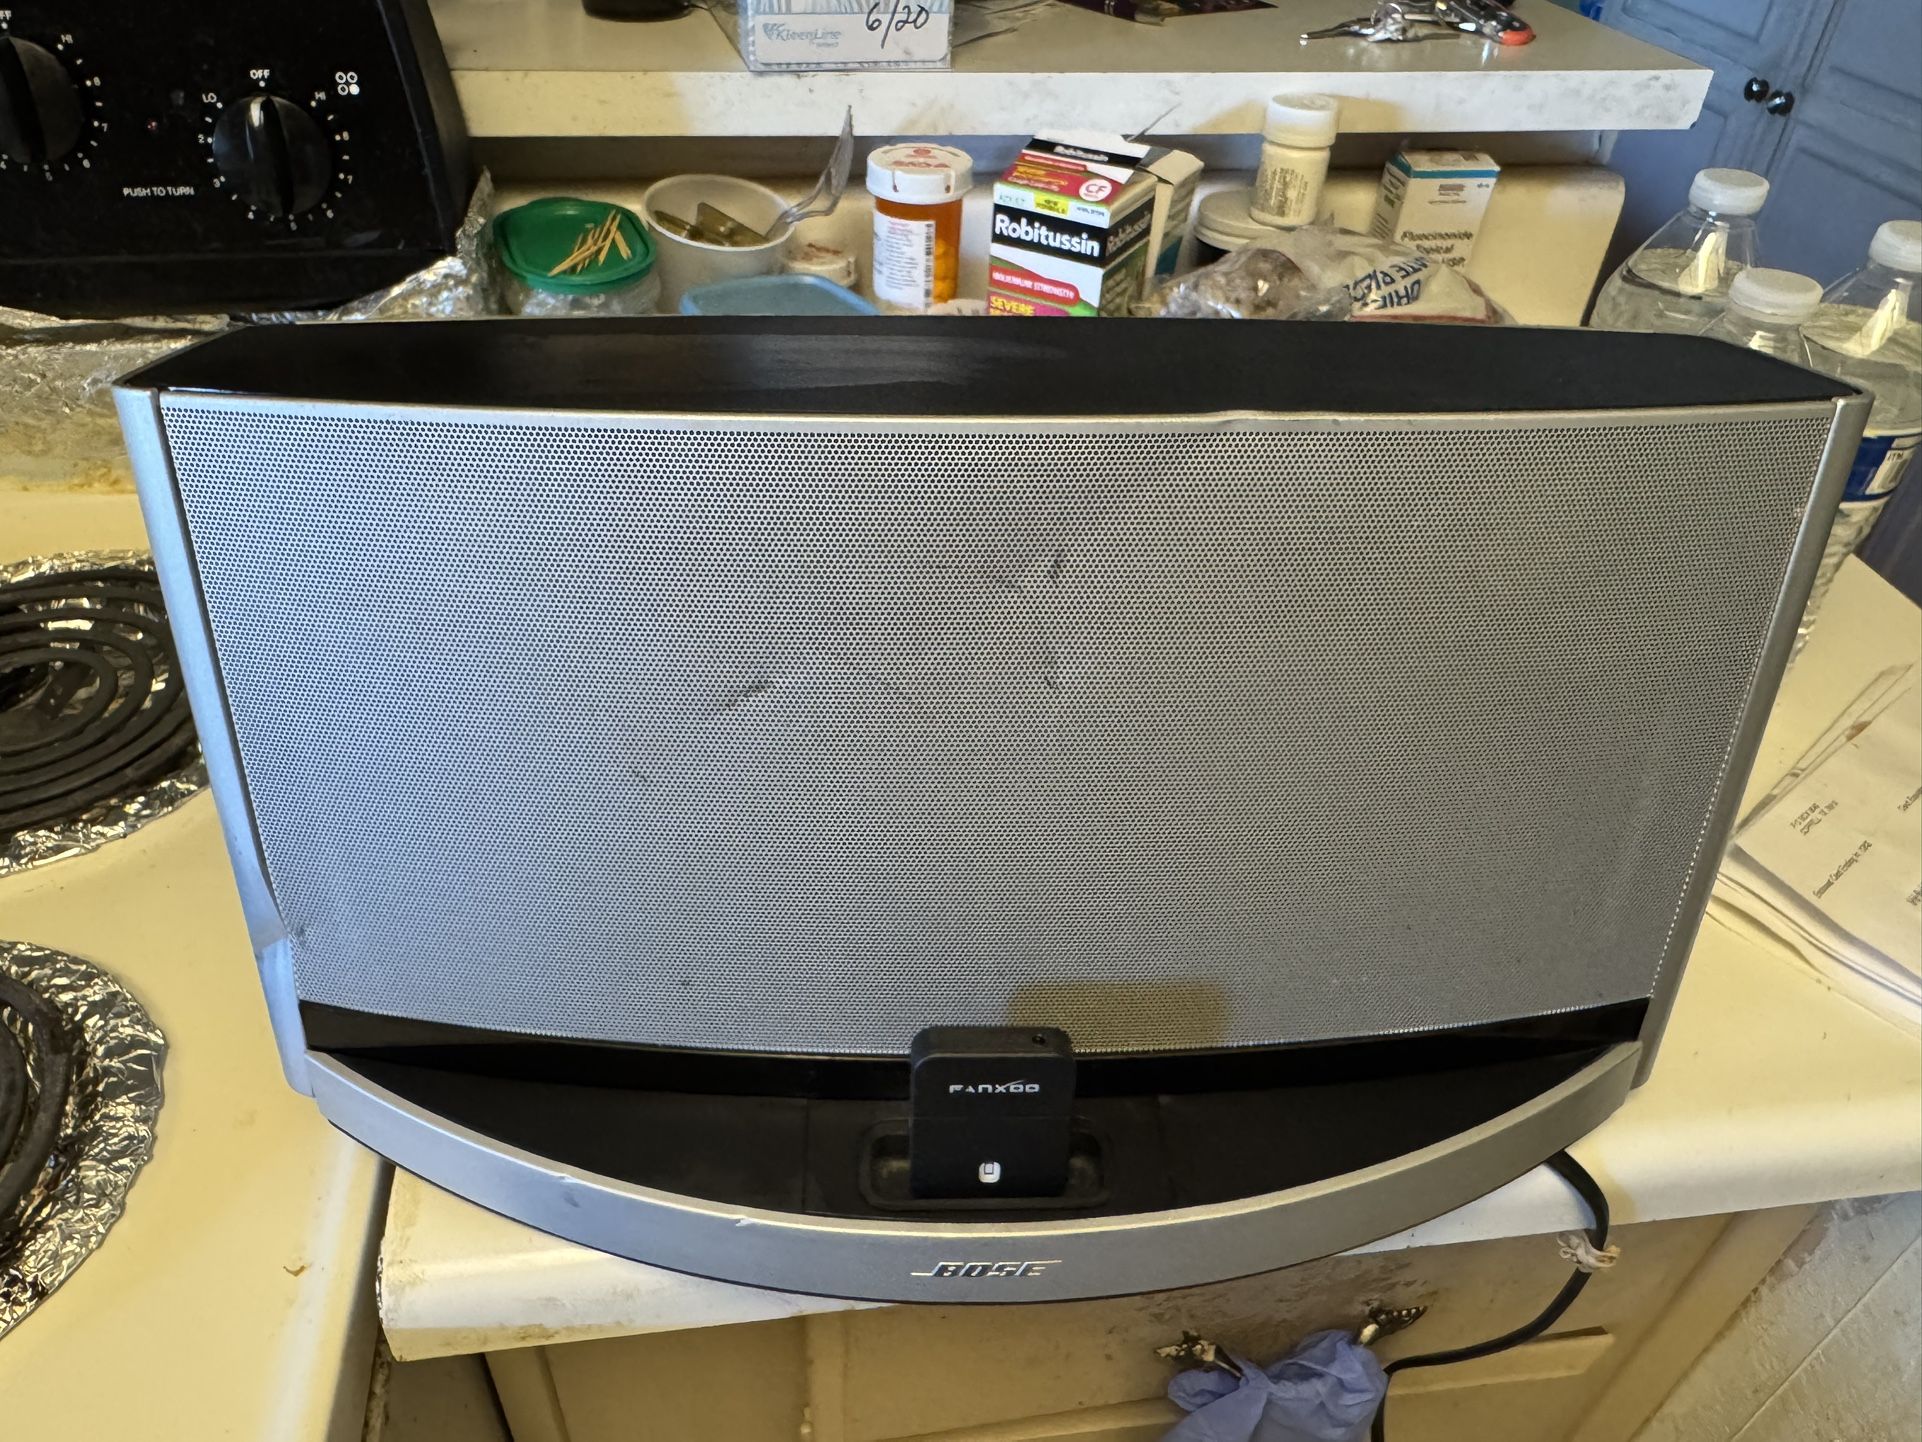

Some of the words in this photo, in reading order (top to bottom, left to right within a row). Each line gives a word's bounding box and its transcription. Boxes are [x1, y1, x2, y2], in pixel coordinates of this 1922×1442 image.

[865, 0, 930, 49] 6/20
[249, 69, 270, 80] OFF
[202, 92, 218, 103] LO
[314, 90, 327, 101] HI
[101, 122, 108, 132] 7
[197, 133, 205, 144] 2
[212, 177, 221, 188] 3
[346, 174, 353, 184] 7
[122, 186, 150, 197] PUSH
[151, 186, 166, 197] TO
[167, 185, 195, 196] TURN
[993, 213, 1101, 258] Robitussin
[909, 1259, 1063, 1278] BOSE
